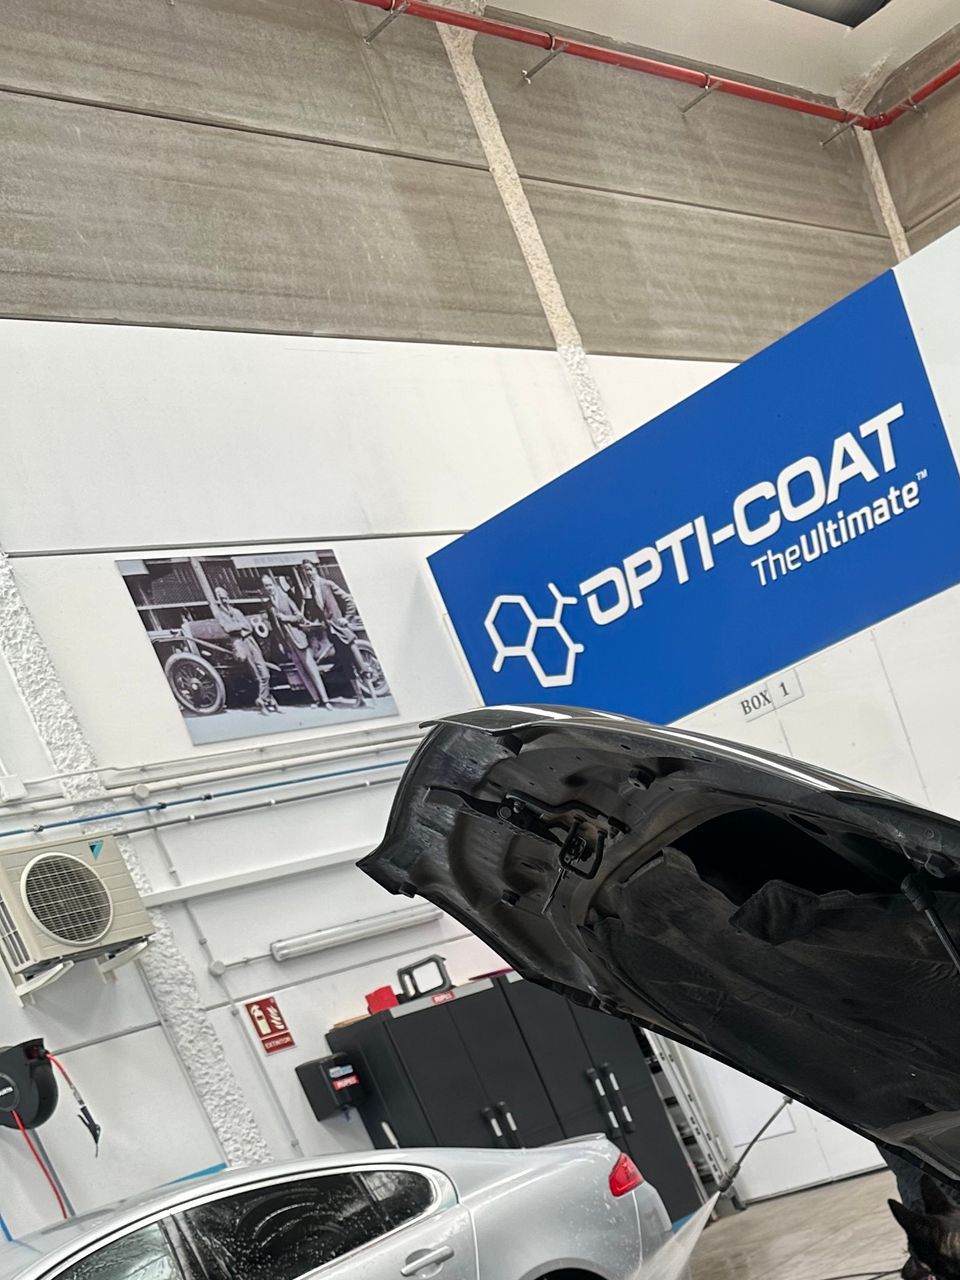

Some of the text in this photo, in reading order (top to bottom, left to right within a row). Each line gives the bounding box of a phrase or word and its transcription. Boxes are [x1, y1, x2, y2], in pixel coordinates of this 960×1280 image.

[579, 402, 905, 625] OPTI-COAT
[741, 681, 790, 716] BOX 1
